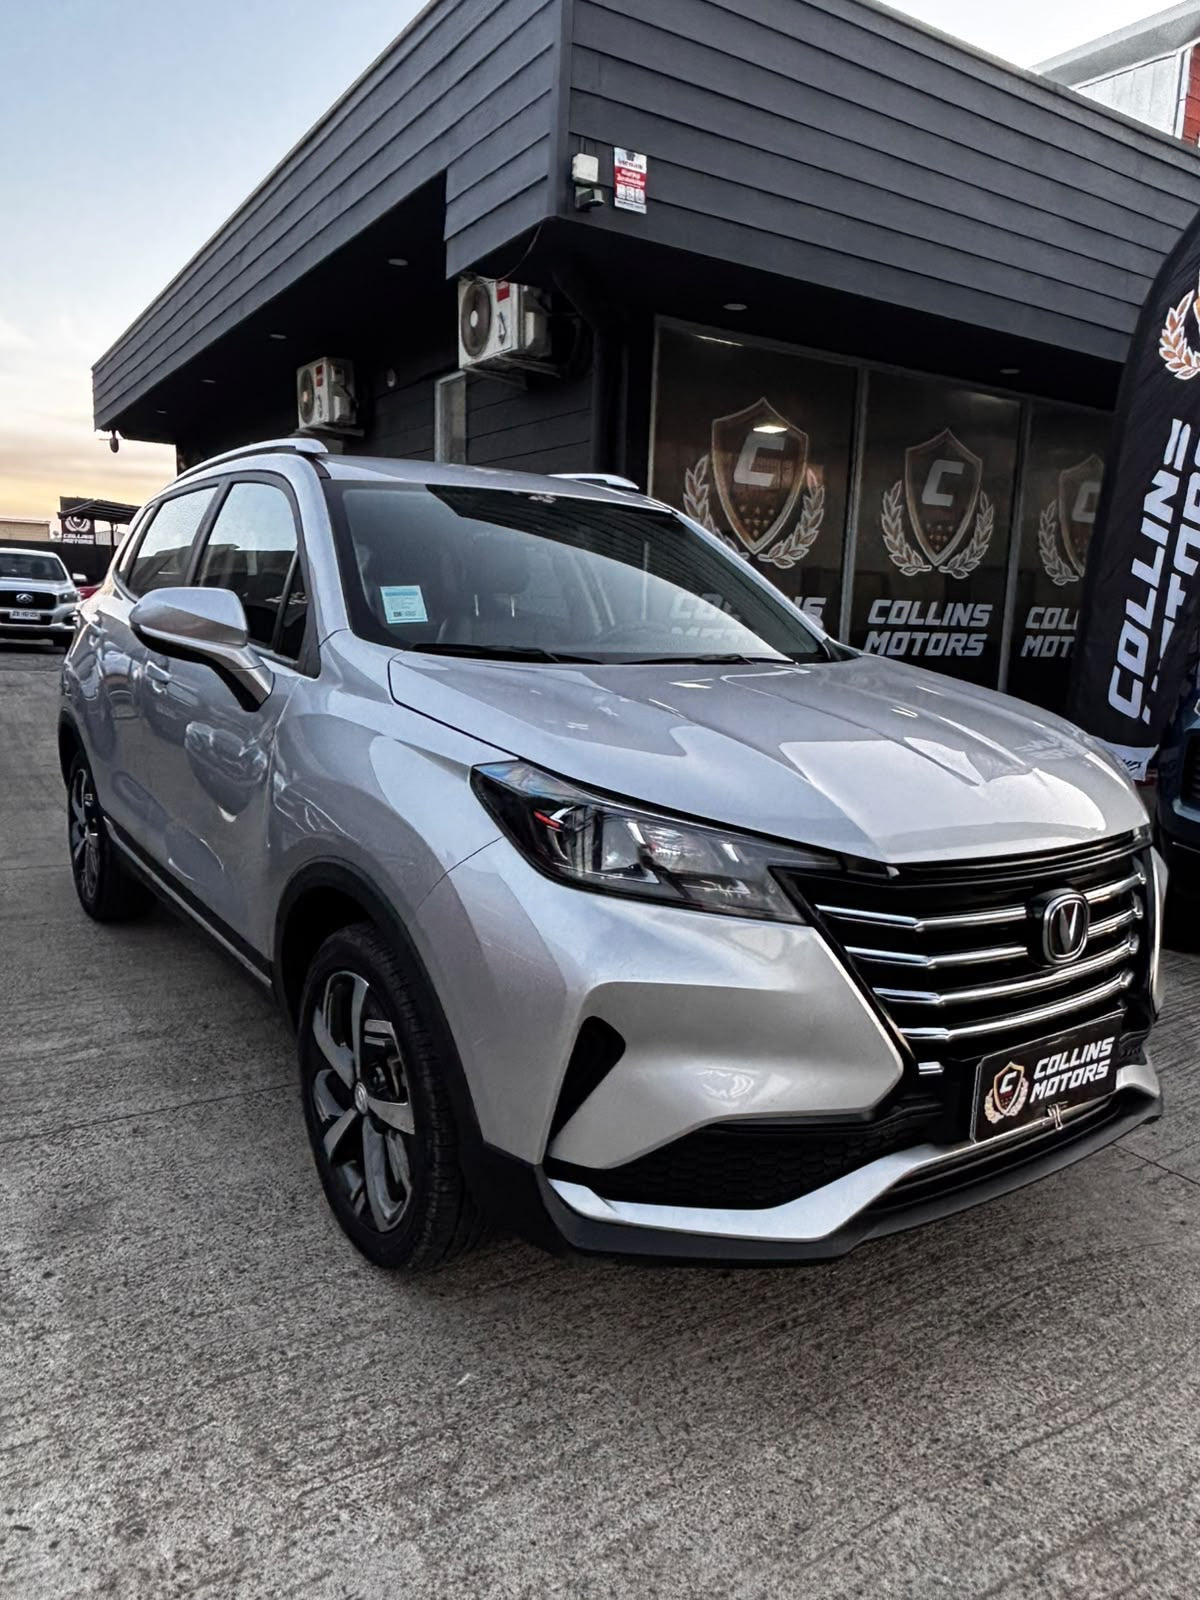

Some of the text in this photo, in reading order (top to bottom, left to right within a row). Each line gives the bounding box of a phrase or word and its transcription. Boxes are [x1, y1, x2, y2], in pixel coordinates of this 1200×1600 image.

[734, 434, 785, 487] C
[922, 459, 964, 507] C
[867, 599, 994, 628] COLLINS
[864, 631, 986, 656] MOTORS
[1033, 1036, 1115, 1080] COLLINS
[1000, 1071, 1017, 1094] C
[1029, 1059, 1111, 1103] MOTORS
